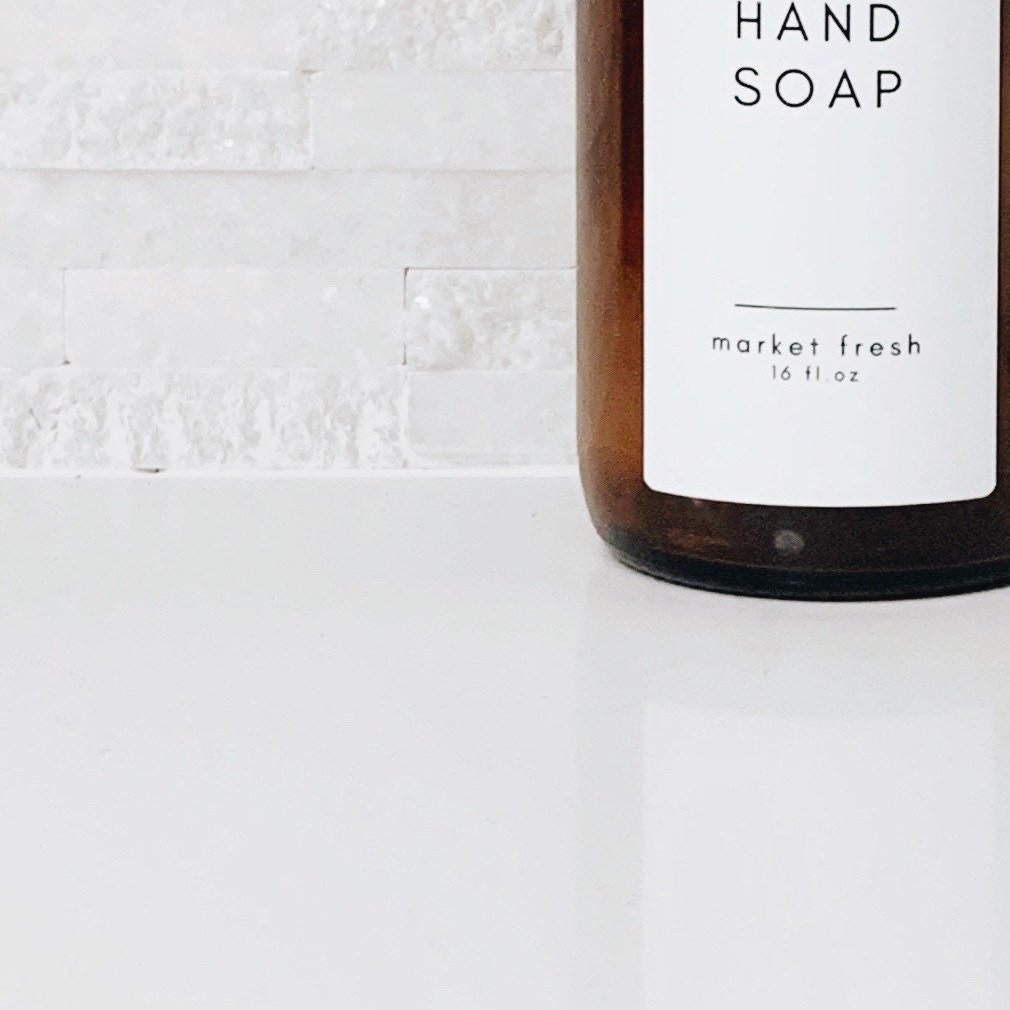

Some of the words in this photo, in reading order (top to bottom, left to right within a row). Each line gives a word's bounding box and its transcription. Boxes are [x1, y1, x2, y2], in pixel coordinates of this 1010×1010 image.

[735, 0, 901, 43] HAND
[734, 66, 903, 109] SOAP
[712, 333, 819, 356] market
[840, 334, 921, 357] fresh
[772, 365, 791, 381] 16
